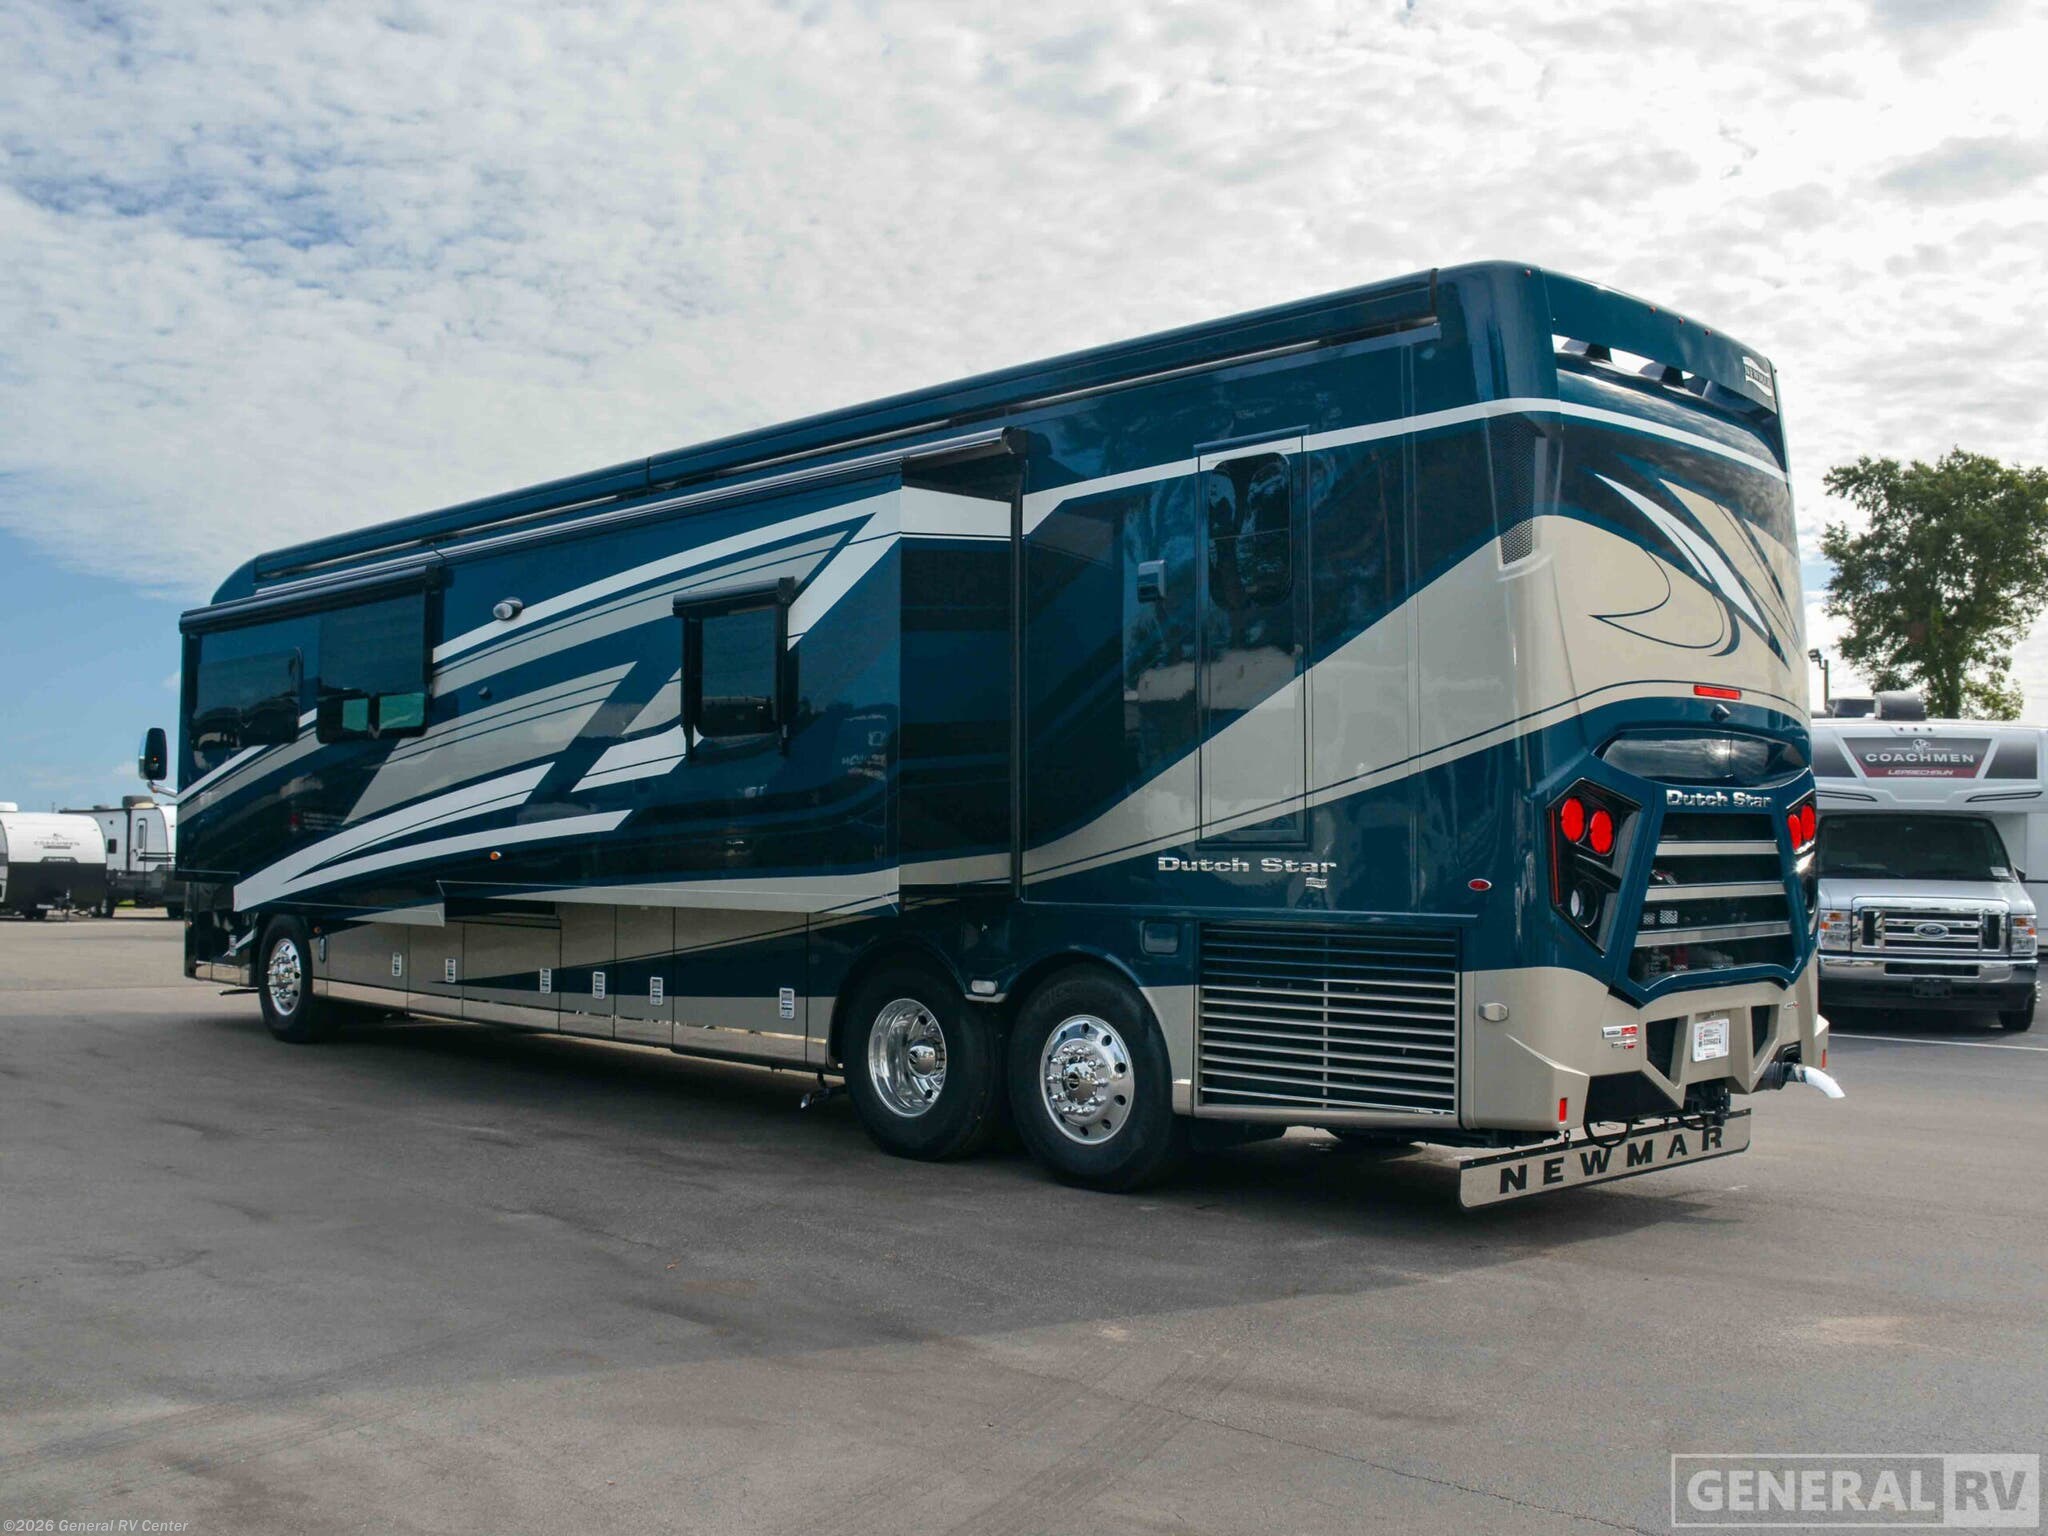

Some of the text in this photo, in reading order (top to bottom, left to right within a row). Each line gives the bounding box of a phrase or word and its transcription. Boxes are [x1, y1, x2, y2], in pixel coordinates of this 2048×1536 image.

[1865, 753, 1975, 763] COACHMEN
[1665, 789, 1772, 808] Dutch Star
[1157, 856, 1337, 873] Dutch Star
[1499, 1126, 1723, 1194] NEWMAR
